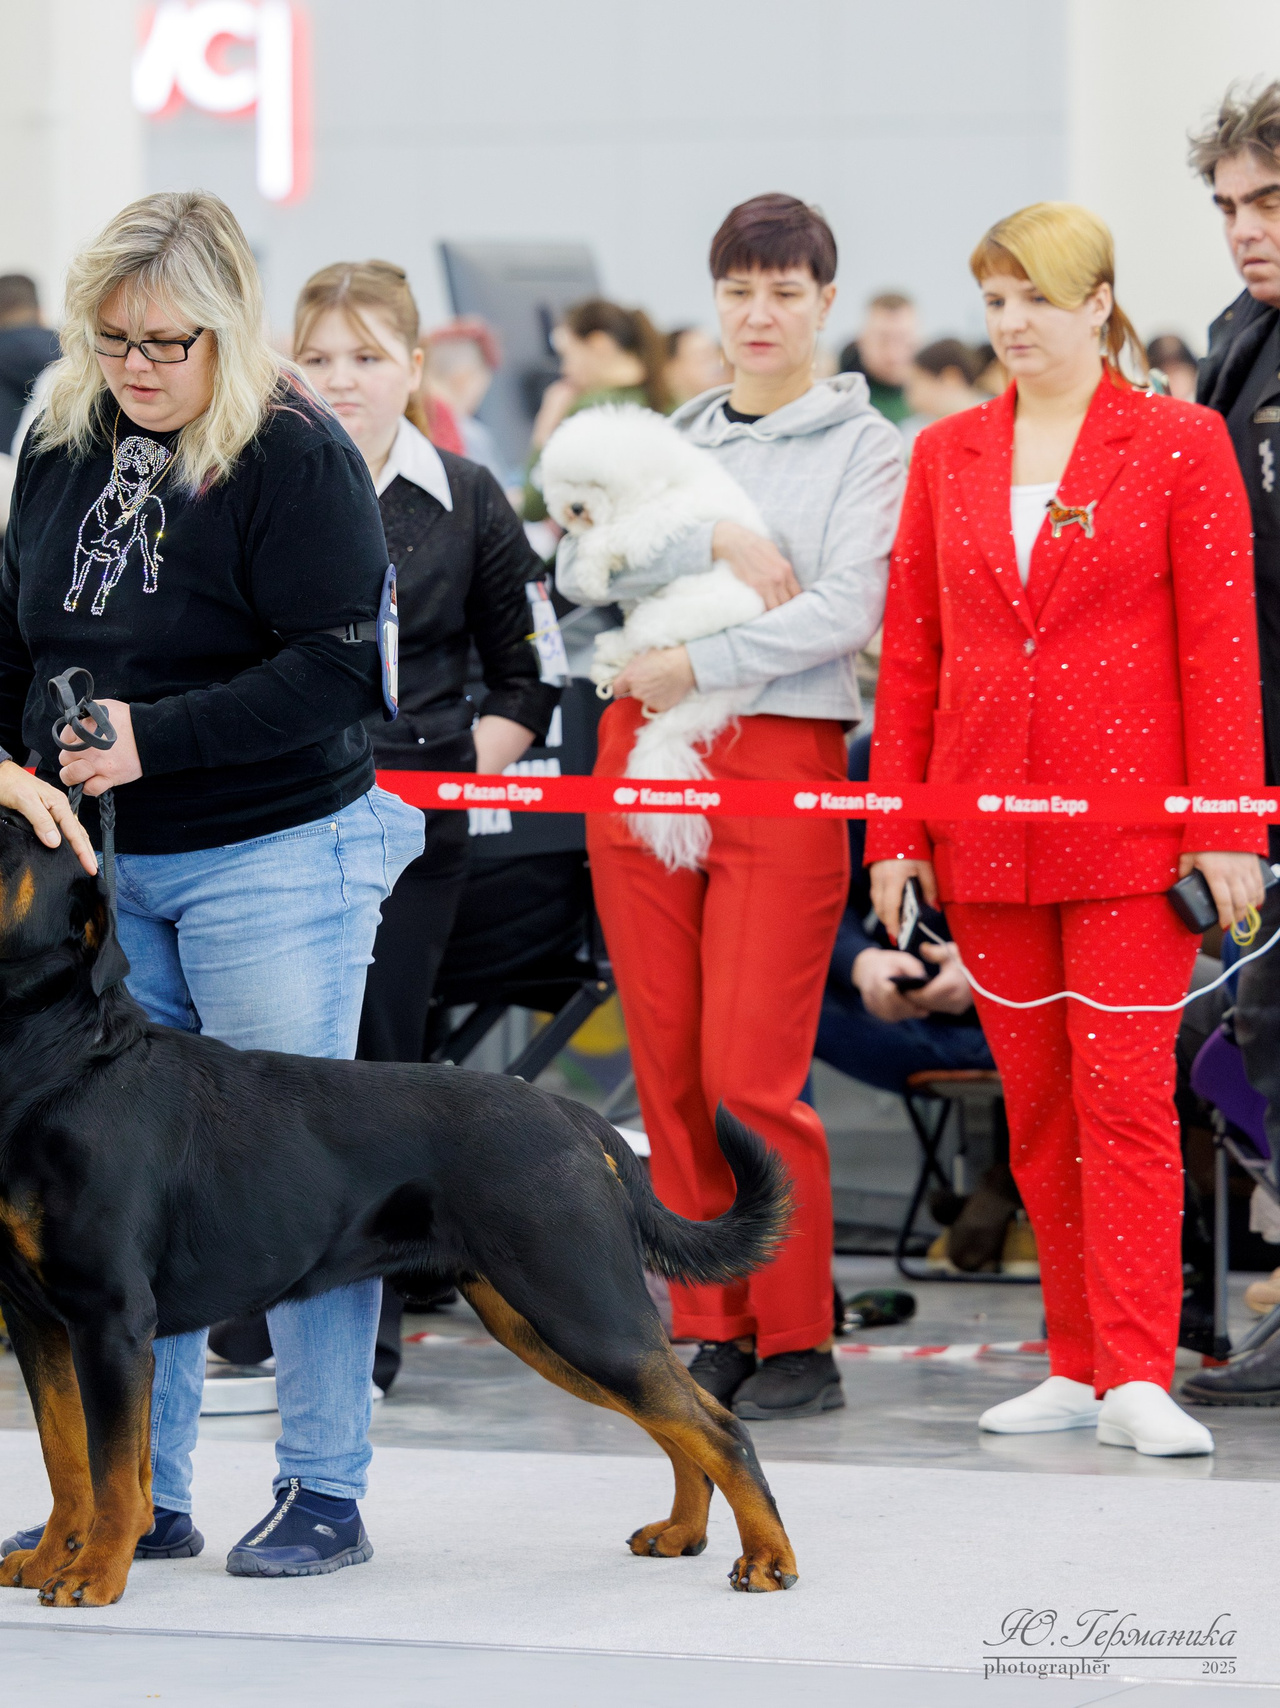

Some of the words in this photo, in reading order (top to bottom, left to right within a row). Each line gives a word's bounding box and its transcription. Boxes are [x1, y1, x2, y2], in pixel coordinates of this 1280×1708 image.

[463, 783, 506, 801] Kazan
[507, 783, 543, 805] Expo
[640, 787, 683, 806] Kazan
[684, 788, 721, 810] Expo
[820, 792, 865, 810] Kazan
[866, 792, 903, 814] Expo
[1004, 795, 1050, 813] Kazan
[1051, 795, 1089, 817] Expo
[1192, 796, 1238, 814] Kazan
[1238, 796, 1278, 817] Expo
